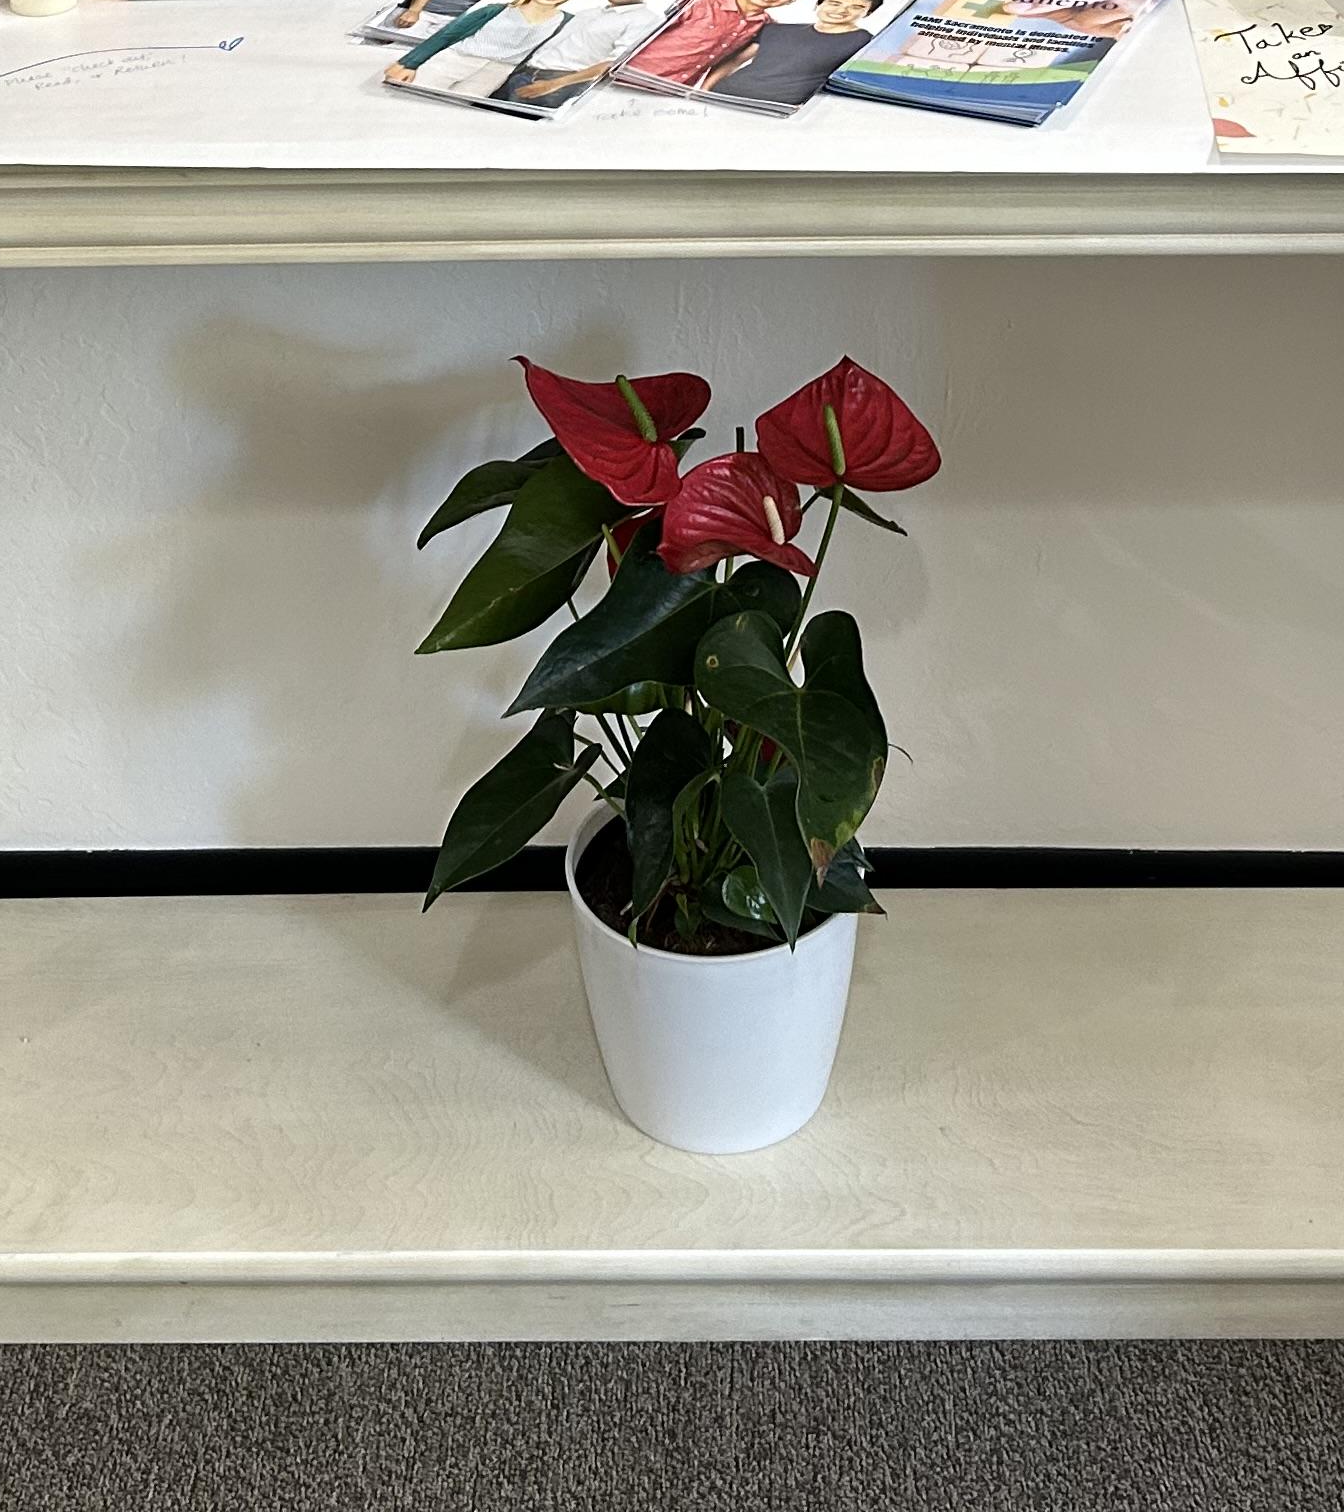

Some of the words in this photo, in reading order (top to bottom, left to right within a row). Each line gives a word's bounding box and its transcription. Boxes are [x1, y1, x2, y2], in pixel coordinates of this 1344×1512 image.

[910, 21, 955, 34] helping
[955, 26, 1020, 42] individuals
[1021, 35, 1045, 44] and
[1214, 21, 1324, 56] Take
[1292, 46, 1322, 62] an
